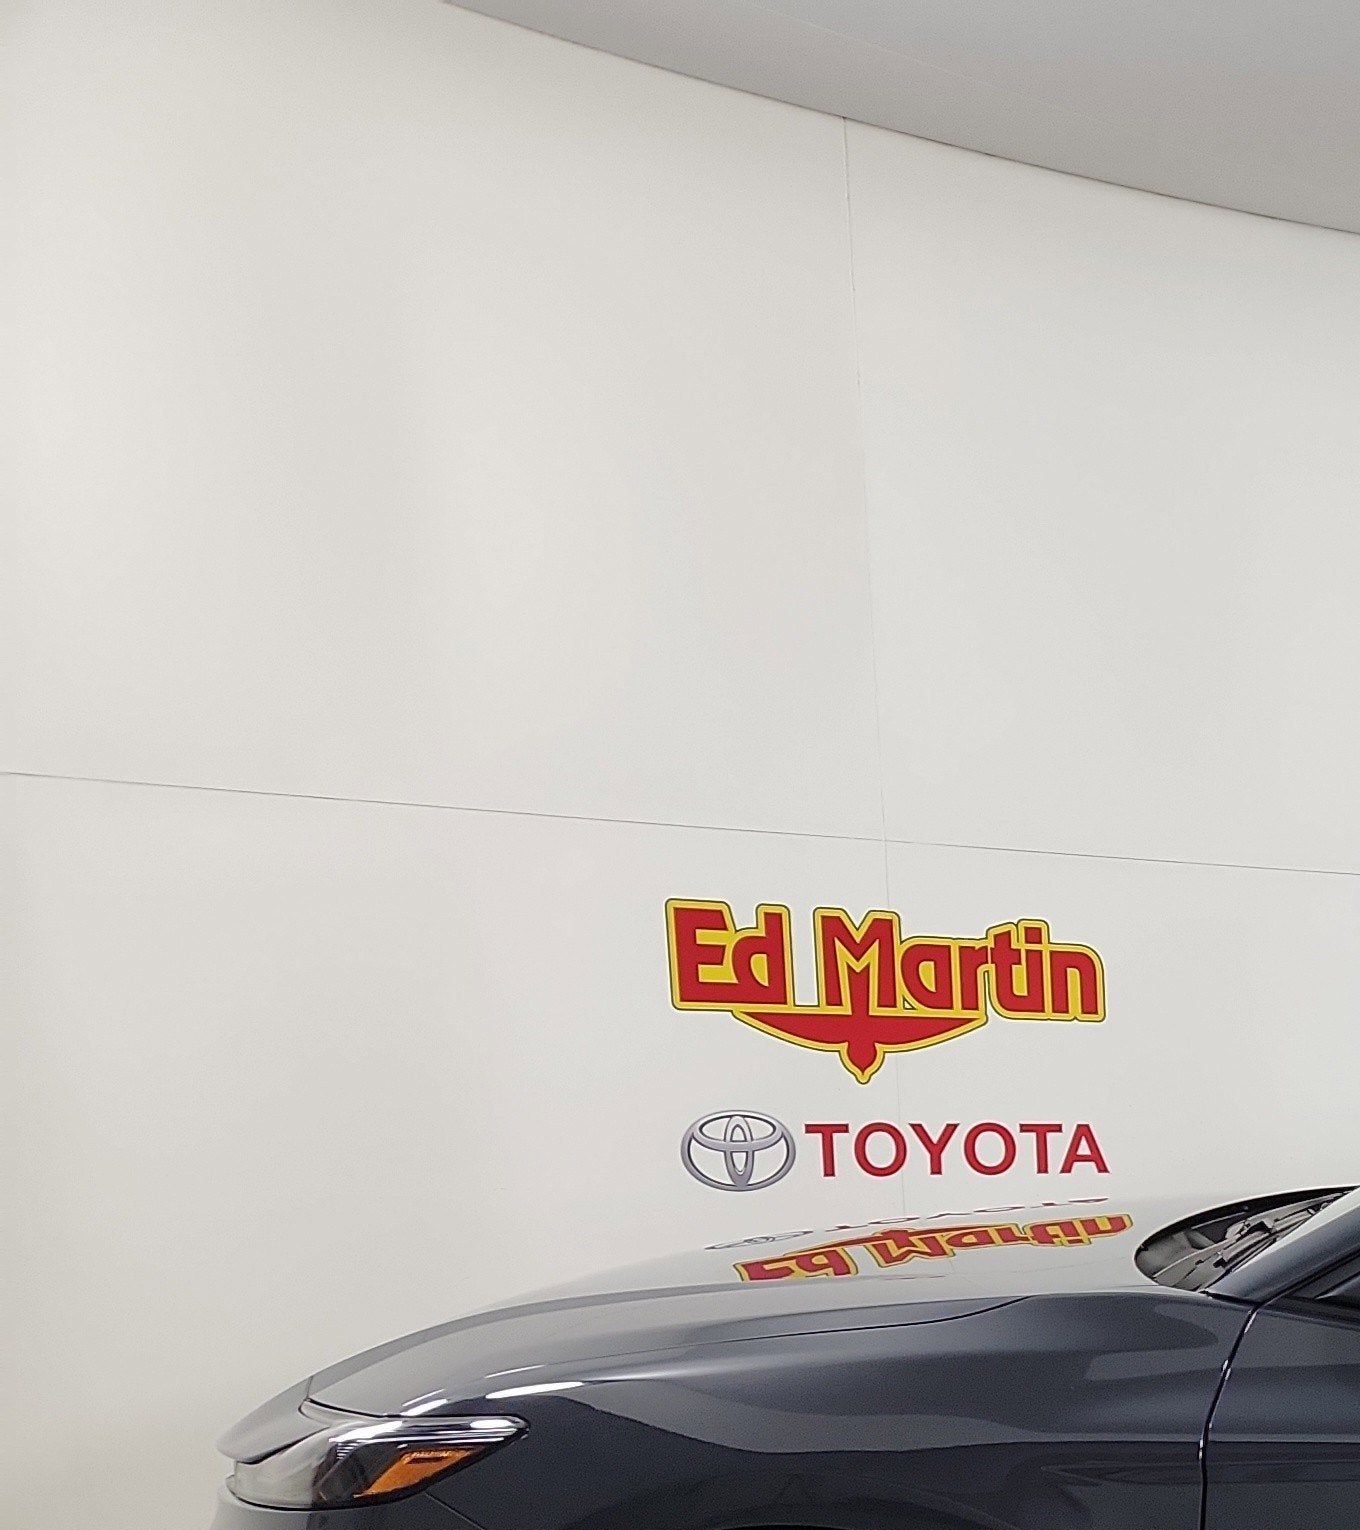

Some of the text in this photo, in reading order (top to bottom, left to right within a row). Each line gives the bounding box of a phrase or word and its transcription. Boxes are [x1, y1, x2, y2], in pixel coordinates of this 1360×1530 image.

[666, 898, 1106, 1022] Ed Martin
[804, 1121, 1111, 1178] TOYOTA
